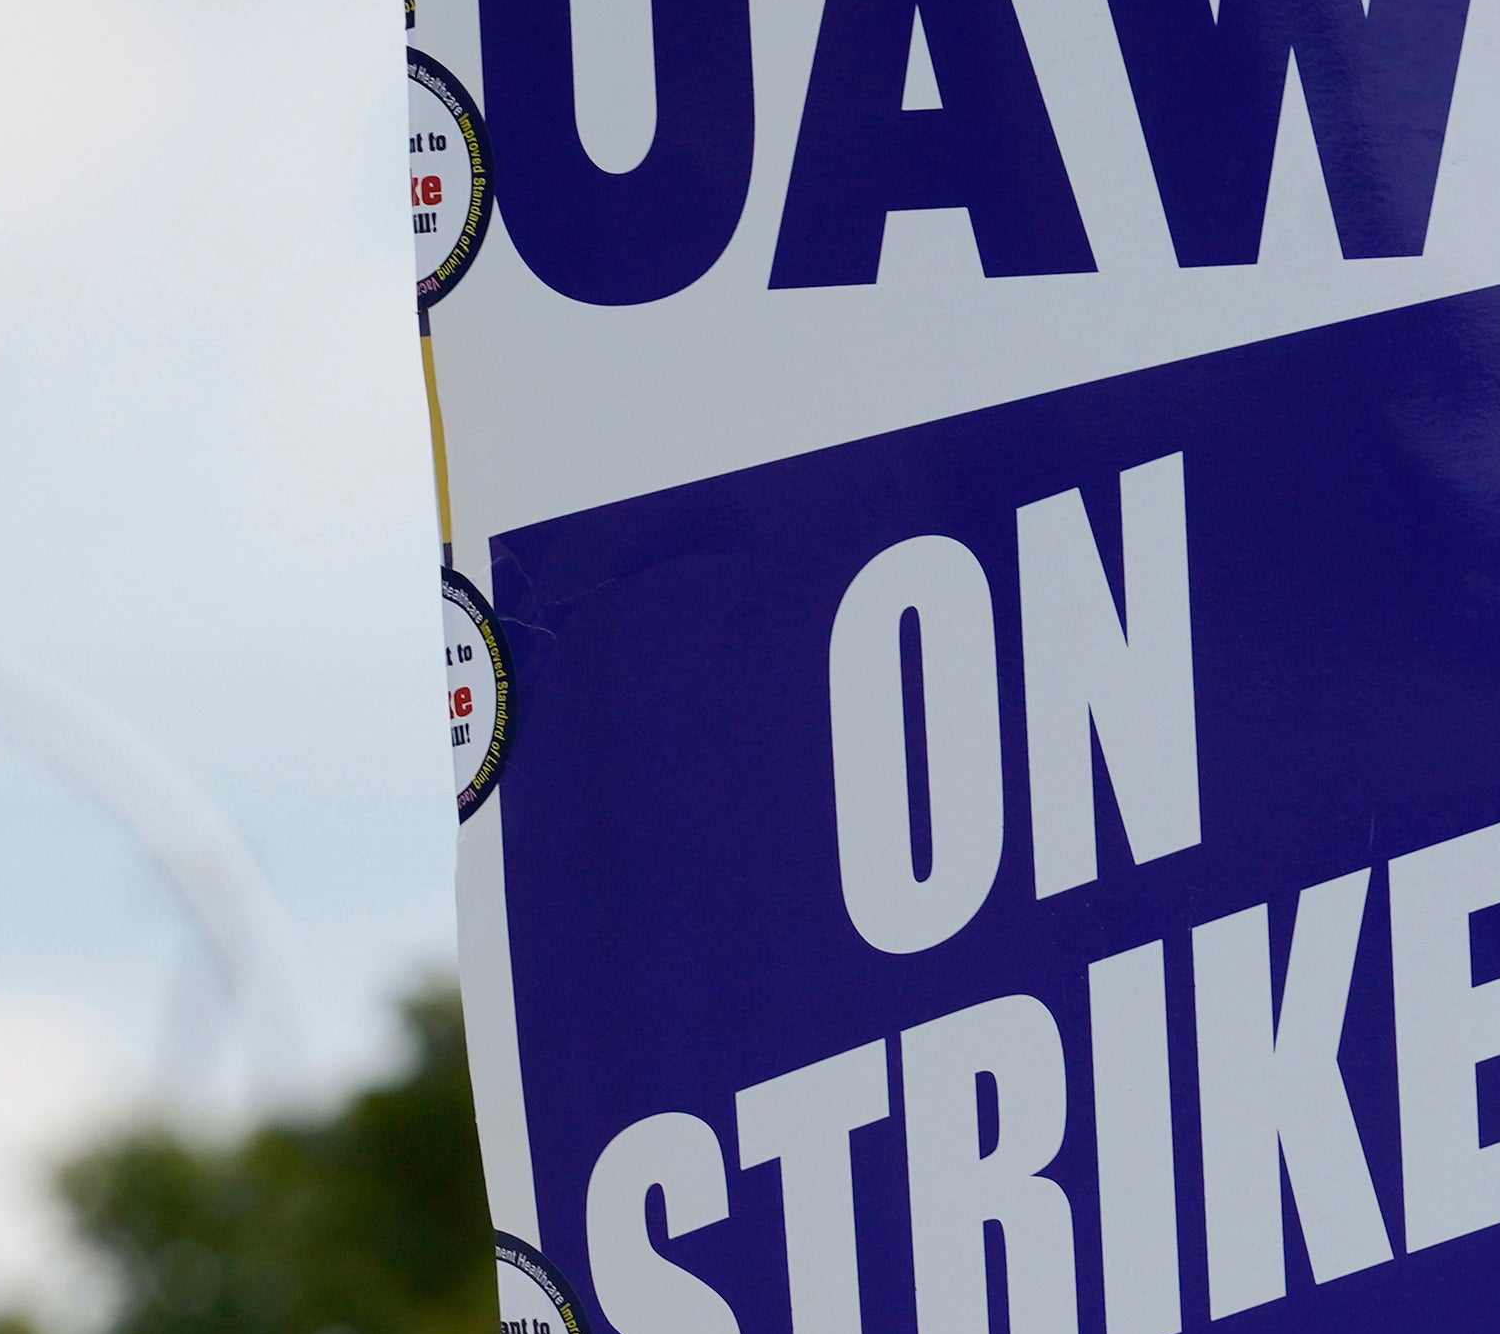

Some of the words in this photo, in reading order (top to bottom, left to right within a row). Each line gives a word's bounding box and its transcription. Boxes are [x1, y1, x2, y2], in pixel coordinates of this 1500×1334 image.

[428, 131, 447, 152] to
[457, 643, 473, 664] to
[829, 450, 1201, 954] ON
